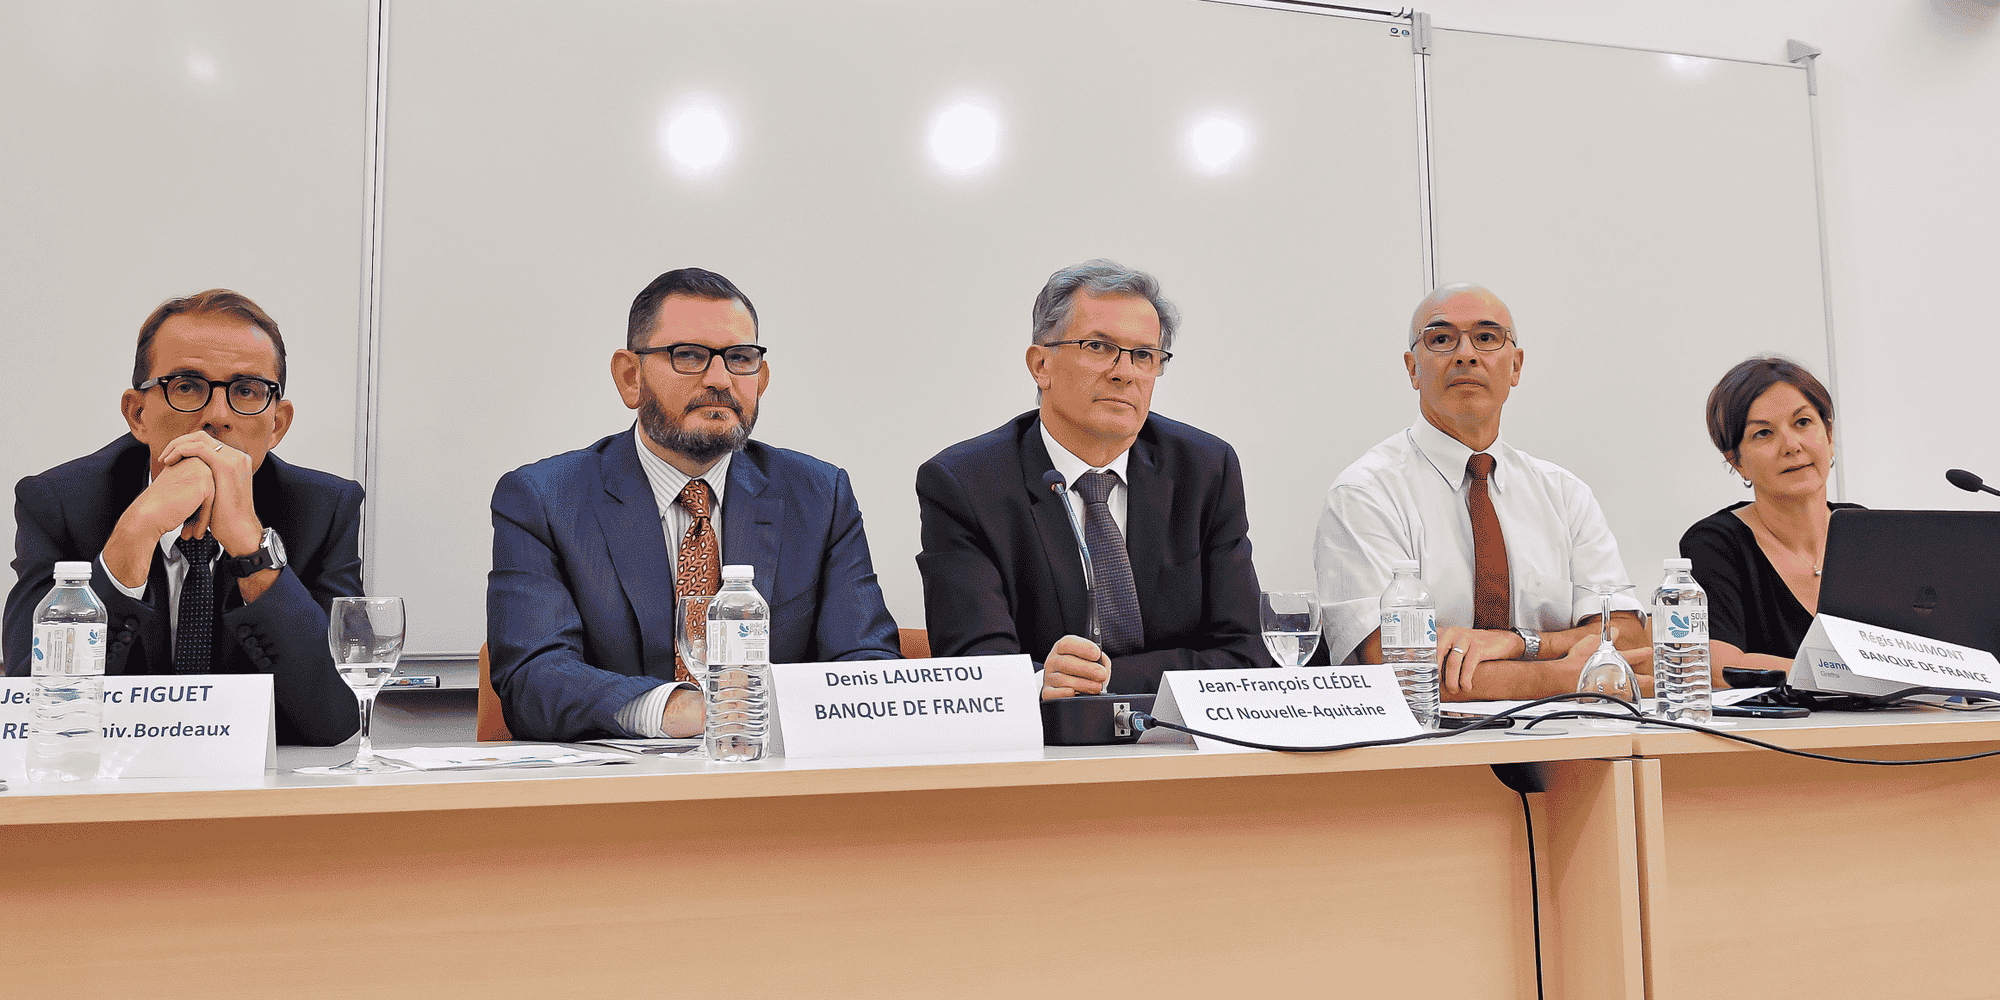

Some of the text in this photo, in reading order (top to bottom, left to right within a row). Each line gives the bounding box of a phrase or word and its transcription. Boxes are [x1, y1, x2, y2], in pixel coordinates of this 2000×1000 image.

[1858, 629, 1965, 661] Régis HAUMONT
[825, 666, 983, 687] Denis LAURETOU
[1858, 649, 1992, 683] BANQUE DE FRANCE
[1198, 672, 1372, 694] Jean-François CLÉDEL
[130, 685, 214, 704] FIGUET
[814, 696, 1005, 720] BANQUE DE FRANCE
[1205, 703, 1387, 721] CCI Nouvelle-Aquitaine
